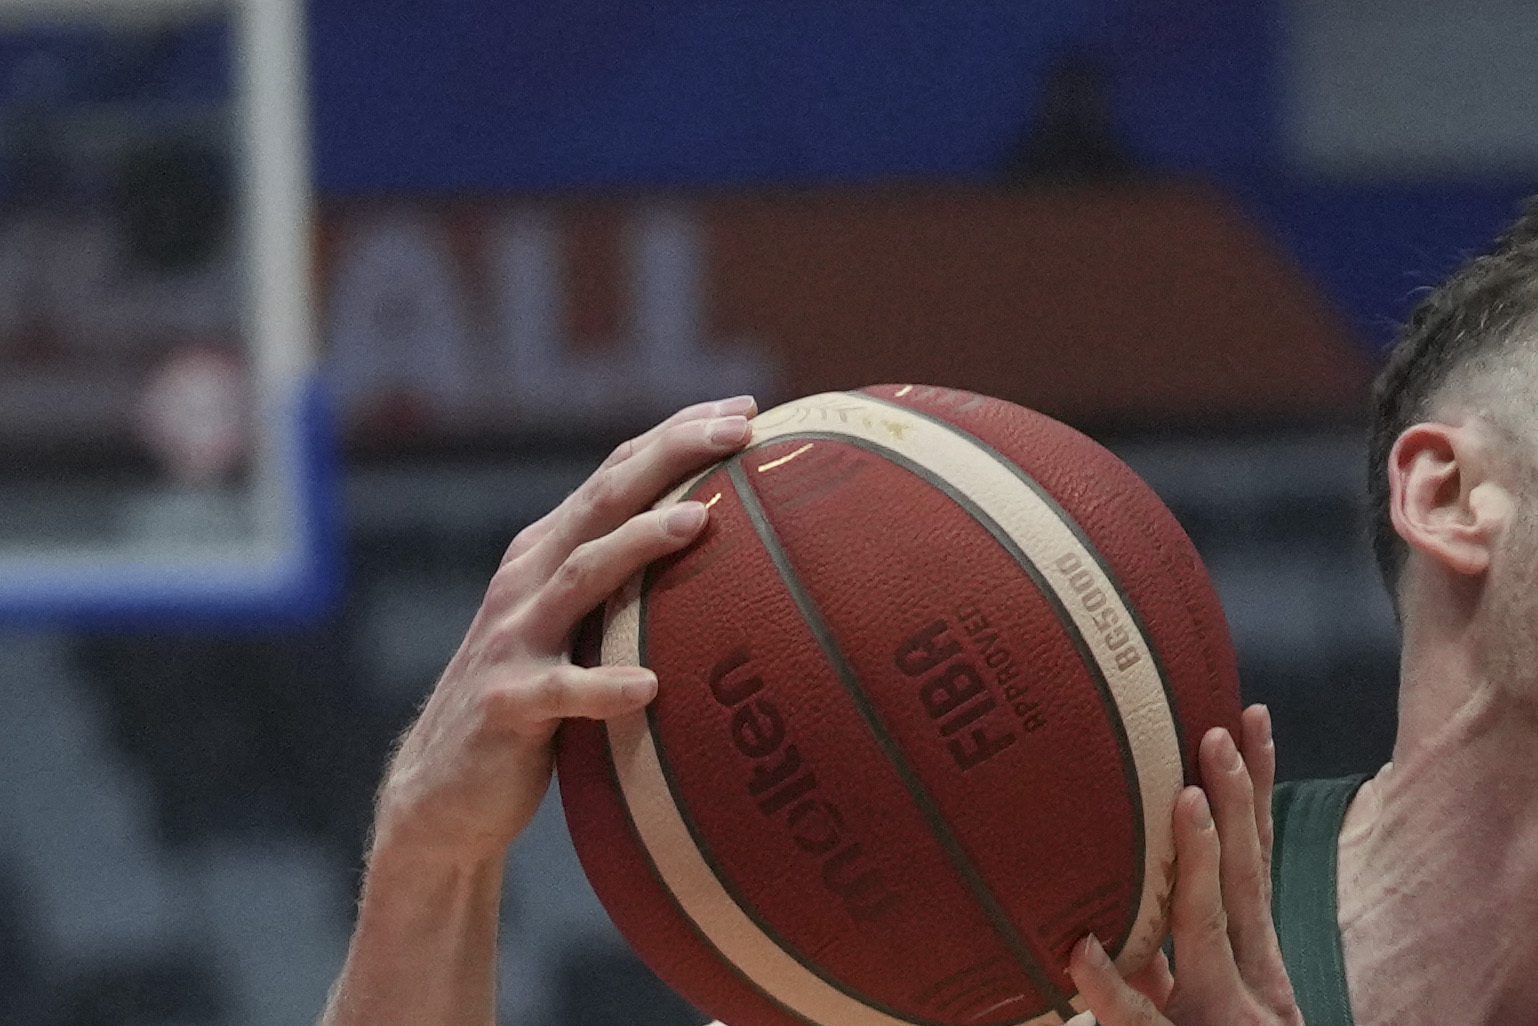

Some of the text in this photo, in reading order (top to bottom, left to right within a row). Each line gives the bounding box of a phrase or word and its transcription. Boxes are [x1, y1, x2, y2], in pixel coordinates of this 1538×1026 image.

[957, 605, 1048, 733] APPROVED
[1055, 552, 1142, 673] BG5000
[895, 618, 1018, 773] FIBA
[708, 645, 903, 923] molten
